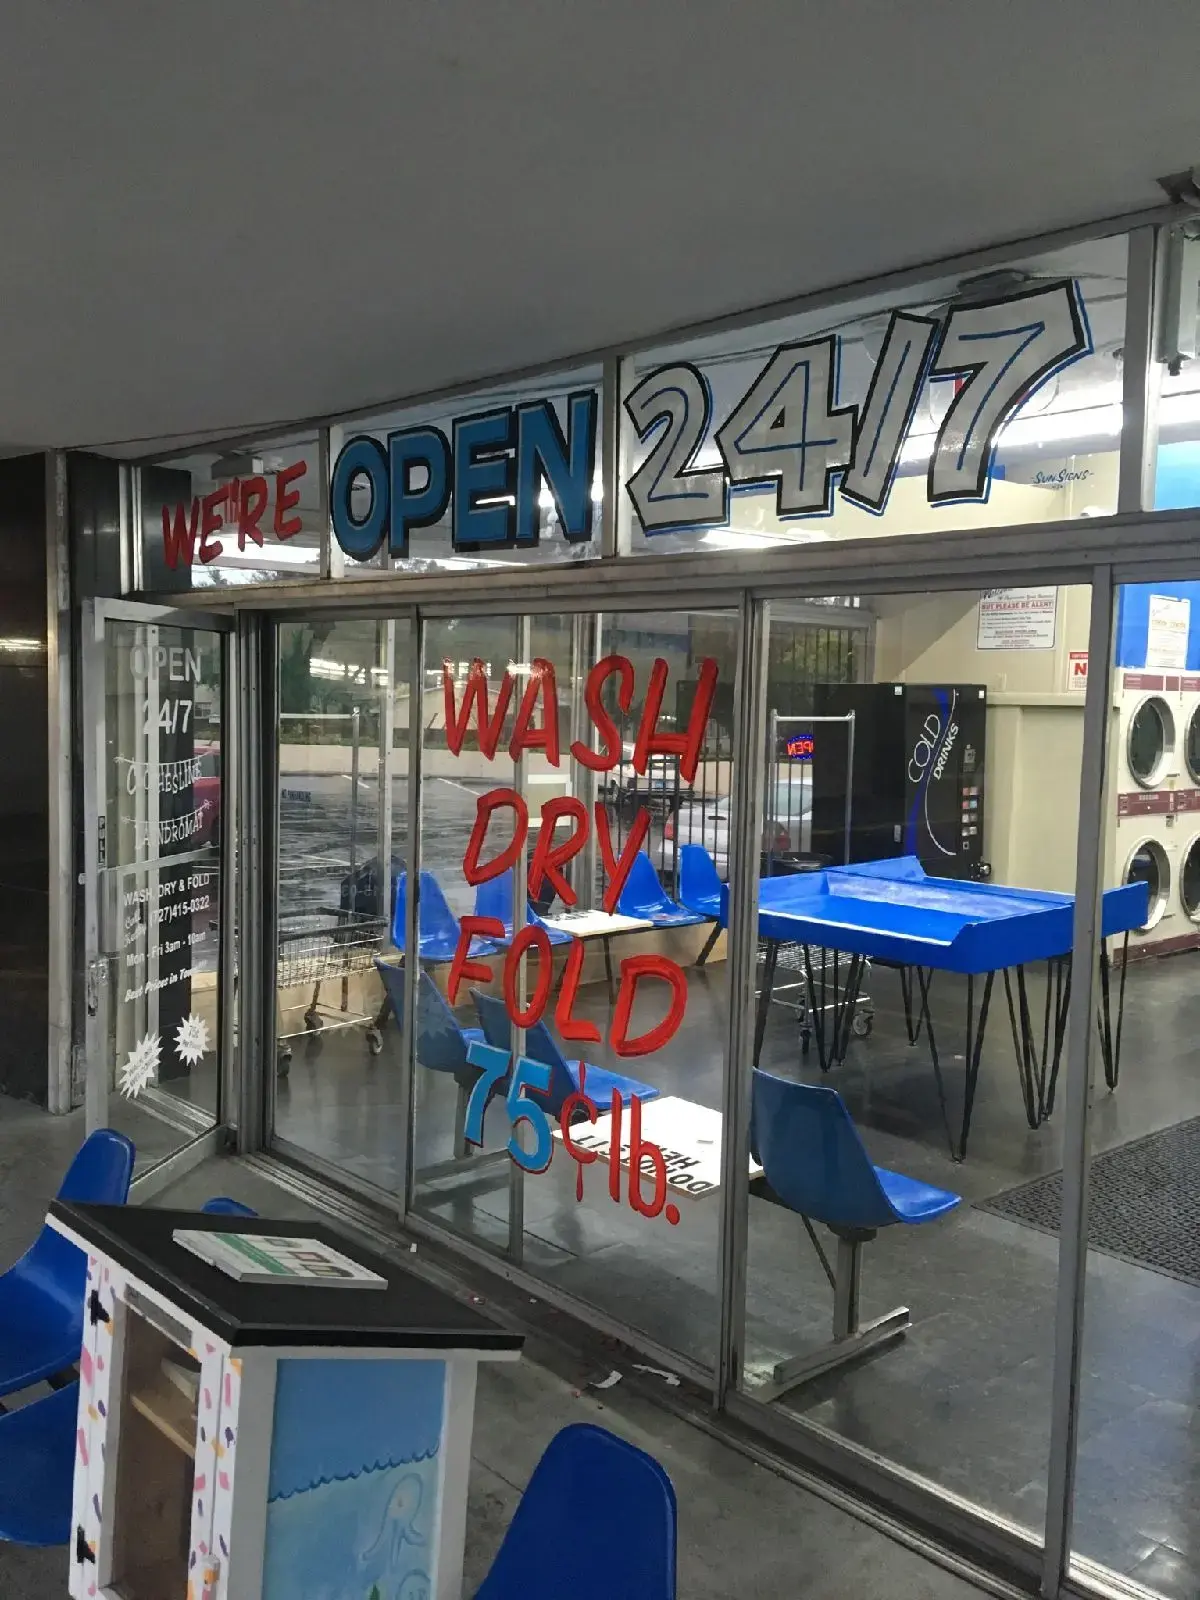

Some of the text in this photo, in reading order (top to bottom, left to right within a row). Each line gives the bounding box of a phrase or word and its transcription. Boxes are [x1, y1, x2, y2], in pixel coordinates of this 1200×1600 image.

[162, 278, 1094, 571] WE'RE OPEN 24/7
[130, 644, 201, 682] OPEN
[443, 654, 719, 784] WASH
[908, 714, 941, 783] COLD
[933, 722, 959, 780] DRINKS
[98, 817, 106, 864] PULL
[463, 788, 650, 916] DRY
[159, 881, 178, 897] DRY
[179, 880, 185, 891] &
[188, 873, 210, 889] FOLD
[126, 953, 145, 967] Mon
[169, 973, 178, 984] in
[447, 915, 688, 1058] FOLD
[669, 1173, 714, 1192] DO
